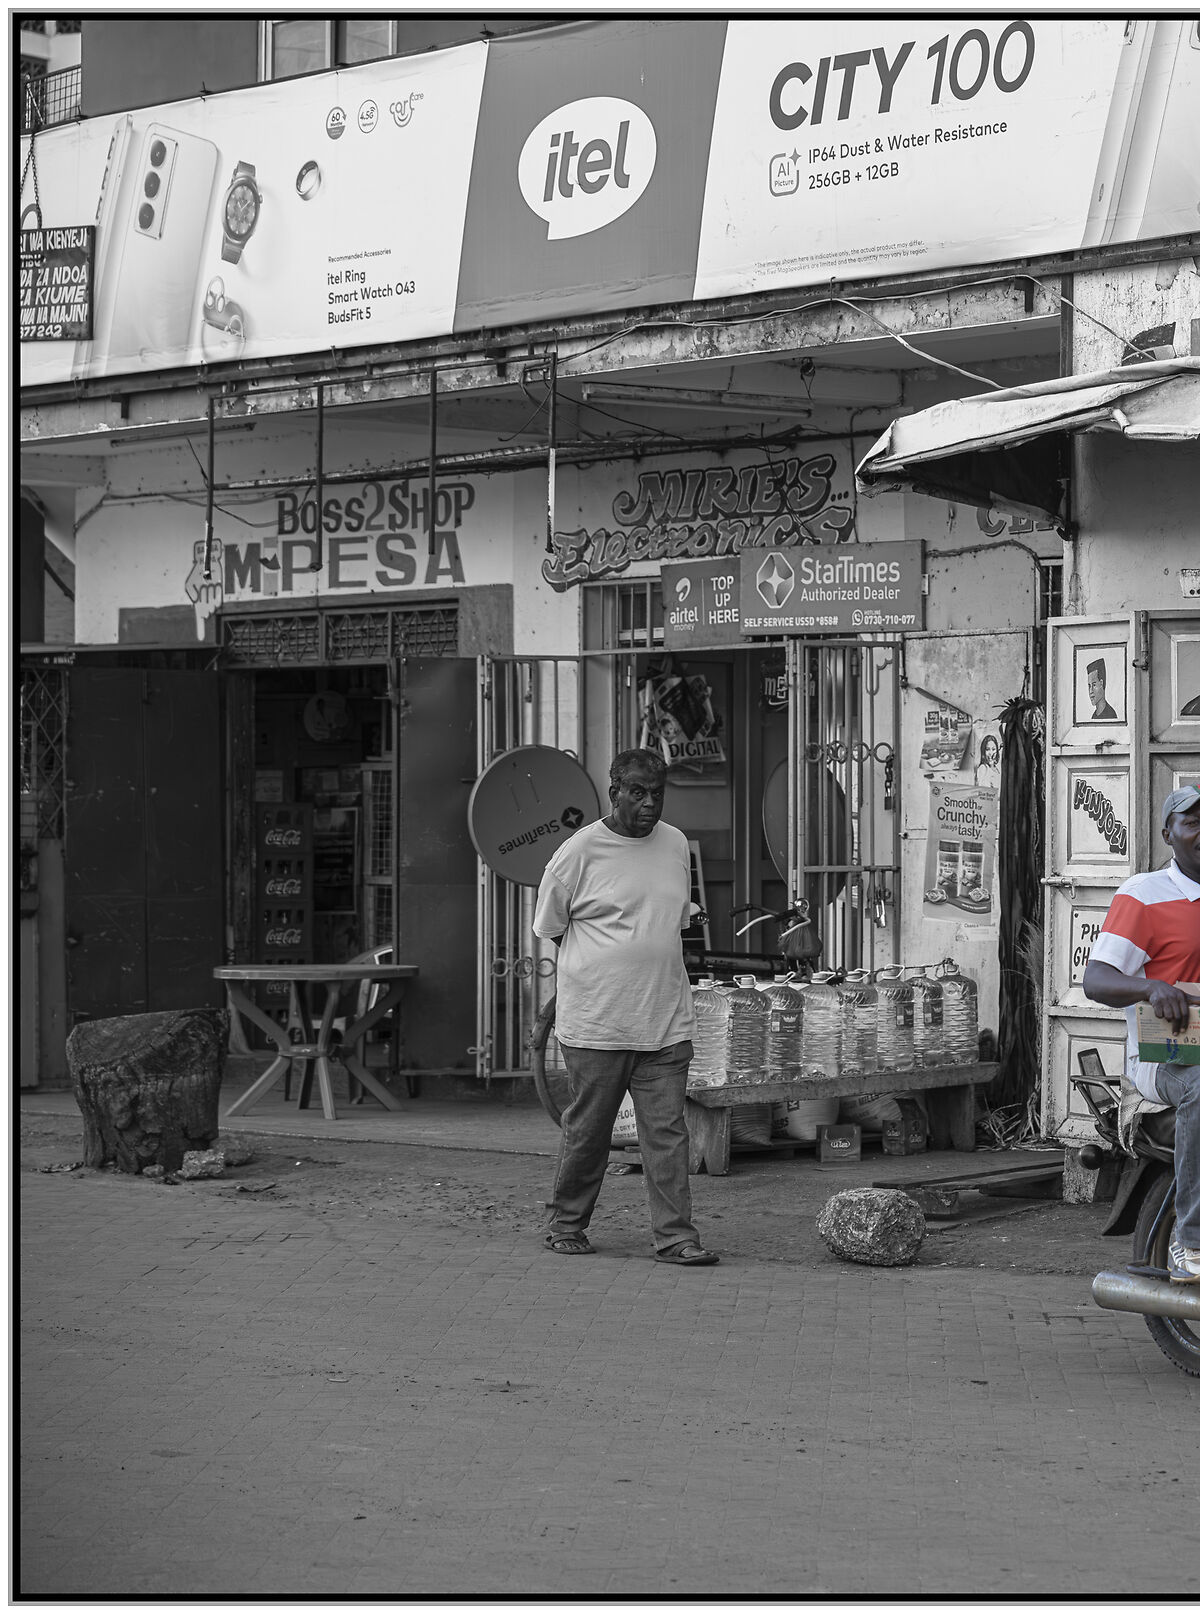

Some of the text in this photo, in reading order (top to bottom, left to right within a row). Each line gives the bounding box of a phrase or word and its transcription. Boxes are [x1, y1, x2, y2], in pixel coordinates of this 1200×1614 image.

[769, 20, 1036, 131] CITY 100
[331, 112, 341, 122] 60
[360, 110, 374, 121] 4.5G
[808, 121, 1008, 164] IP64 Dust & Water Resistance
[543, 120, 631, 202] itel
[777, 162, 791, 178] AI
[808, 161, 899, 190] 256GB + 12GB
[774, 179, 794, 188] Picture
[327, 248, 392, 263] Recommended Accessories
[52, 265, 88, 285] NDOA
[327, 269, 366, 285] itel Ring
[35, 285, 87, 305] KIUME
[328, 290, 359, 305] Smart
[360, 283, 393, 301] Watch
[50, 303, 88, 323] MAJINI
[328, 306, 372, 325] BudsFit 5
[800, 555, 901, 585] StarTimes
[710, 575, 734, 591] TOP
[715, 592, 731, 608] UP
[800, 585, 901, 602] Authorized Dealer
[670, 606, 699, 624] airtel
[708, 608, 740, 625] HERE
[744, 617, 763, 628] SELF
[763, 616, 794, 628] SERVICE
[795, 616, 815, 626] USSD
[864, 614, 916, 625] 0730-710-077
[673, 622, 695, 632] money
[669, 739, 721, 758] DIGITAL
[944, 796, 978, 810] Smooth
[937, 806, 989, 828] Crunchy,
[1074, 778, 1128, 856] KINYOZI
[498, 819, 561, 855] StarTimes
[958, 824, 983, 840] tasty.
